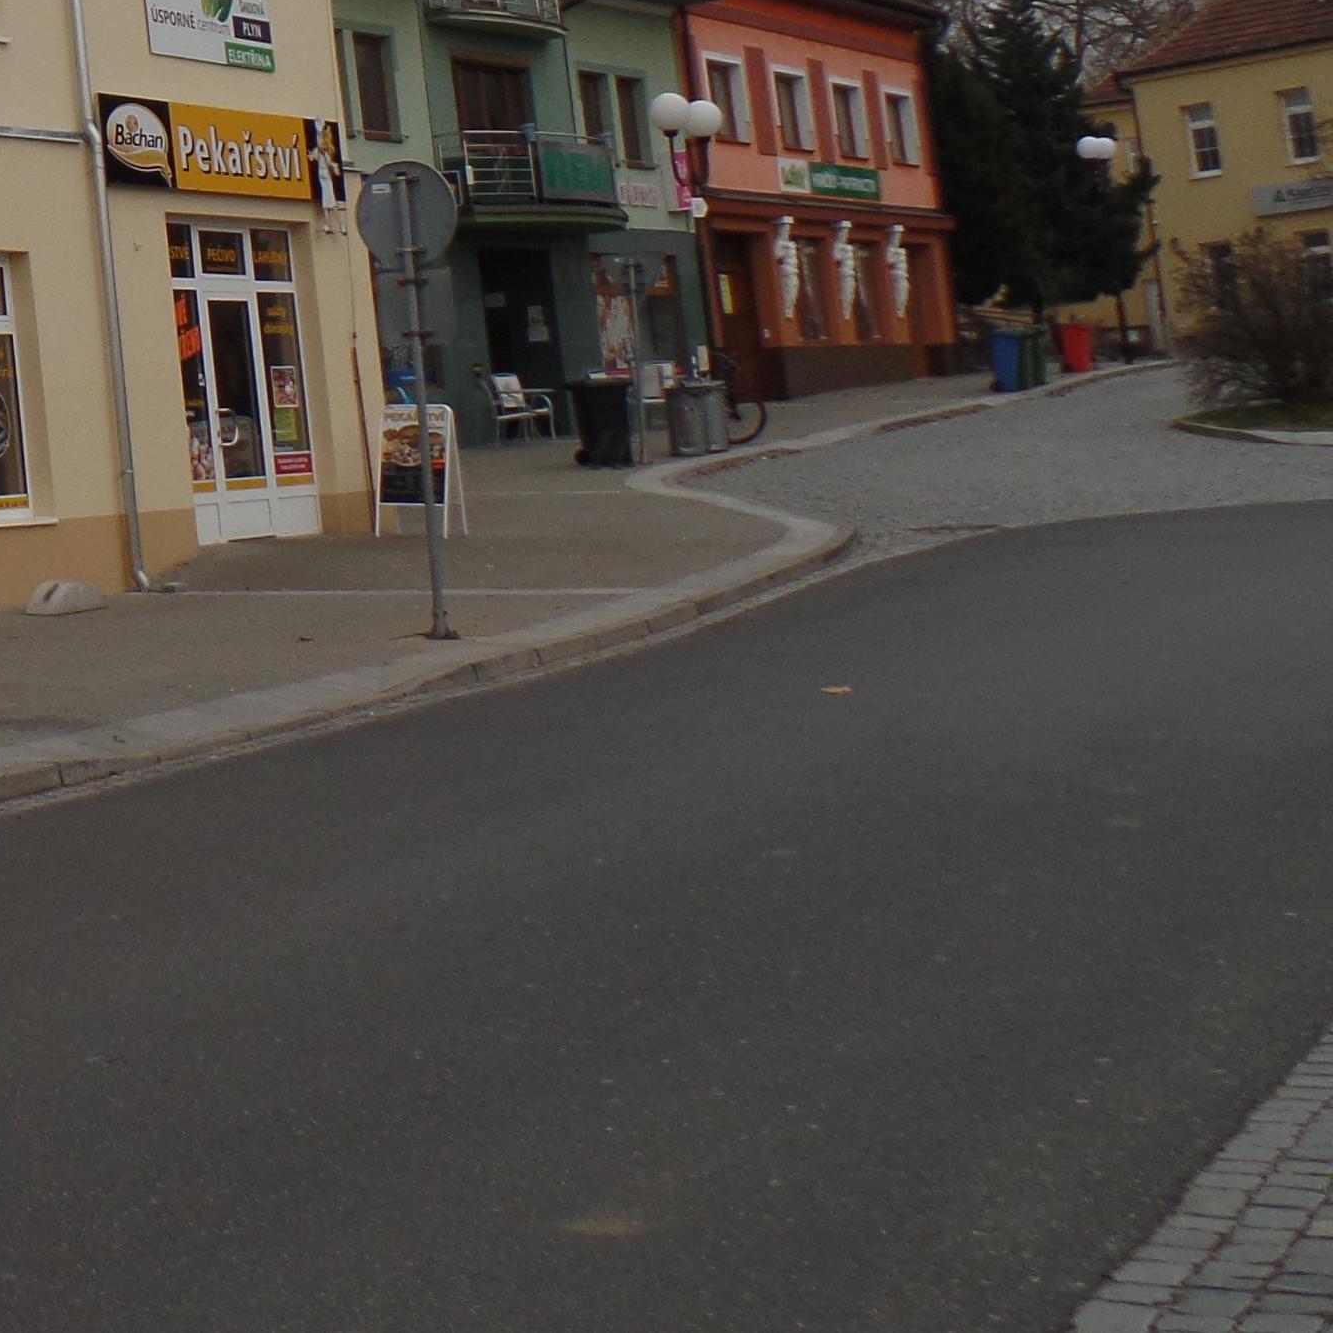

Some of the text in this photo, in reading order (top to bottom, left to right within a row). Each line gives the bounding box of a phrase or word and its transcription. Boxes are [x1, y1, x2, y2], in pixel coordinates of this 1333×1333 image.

[150, 5, 230, 35] ÚSPORNÉ centrum
[242, 20, 262, 39] PLYN
[115, 124, 163, 149] Bachan
[177, 125, 303, 181] Pekařství
